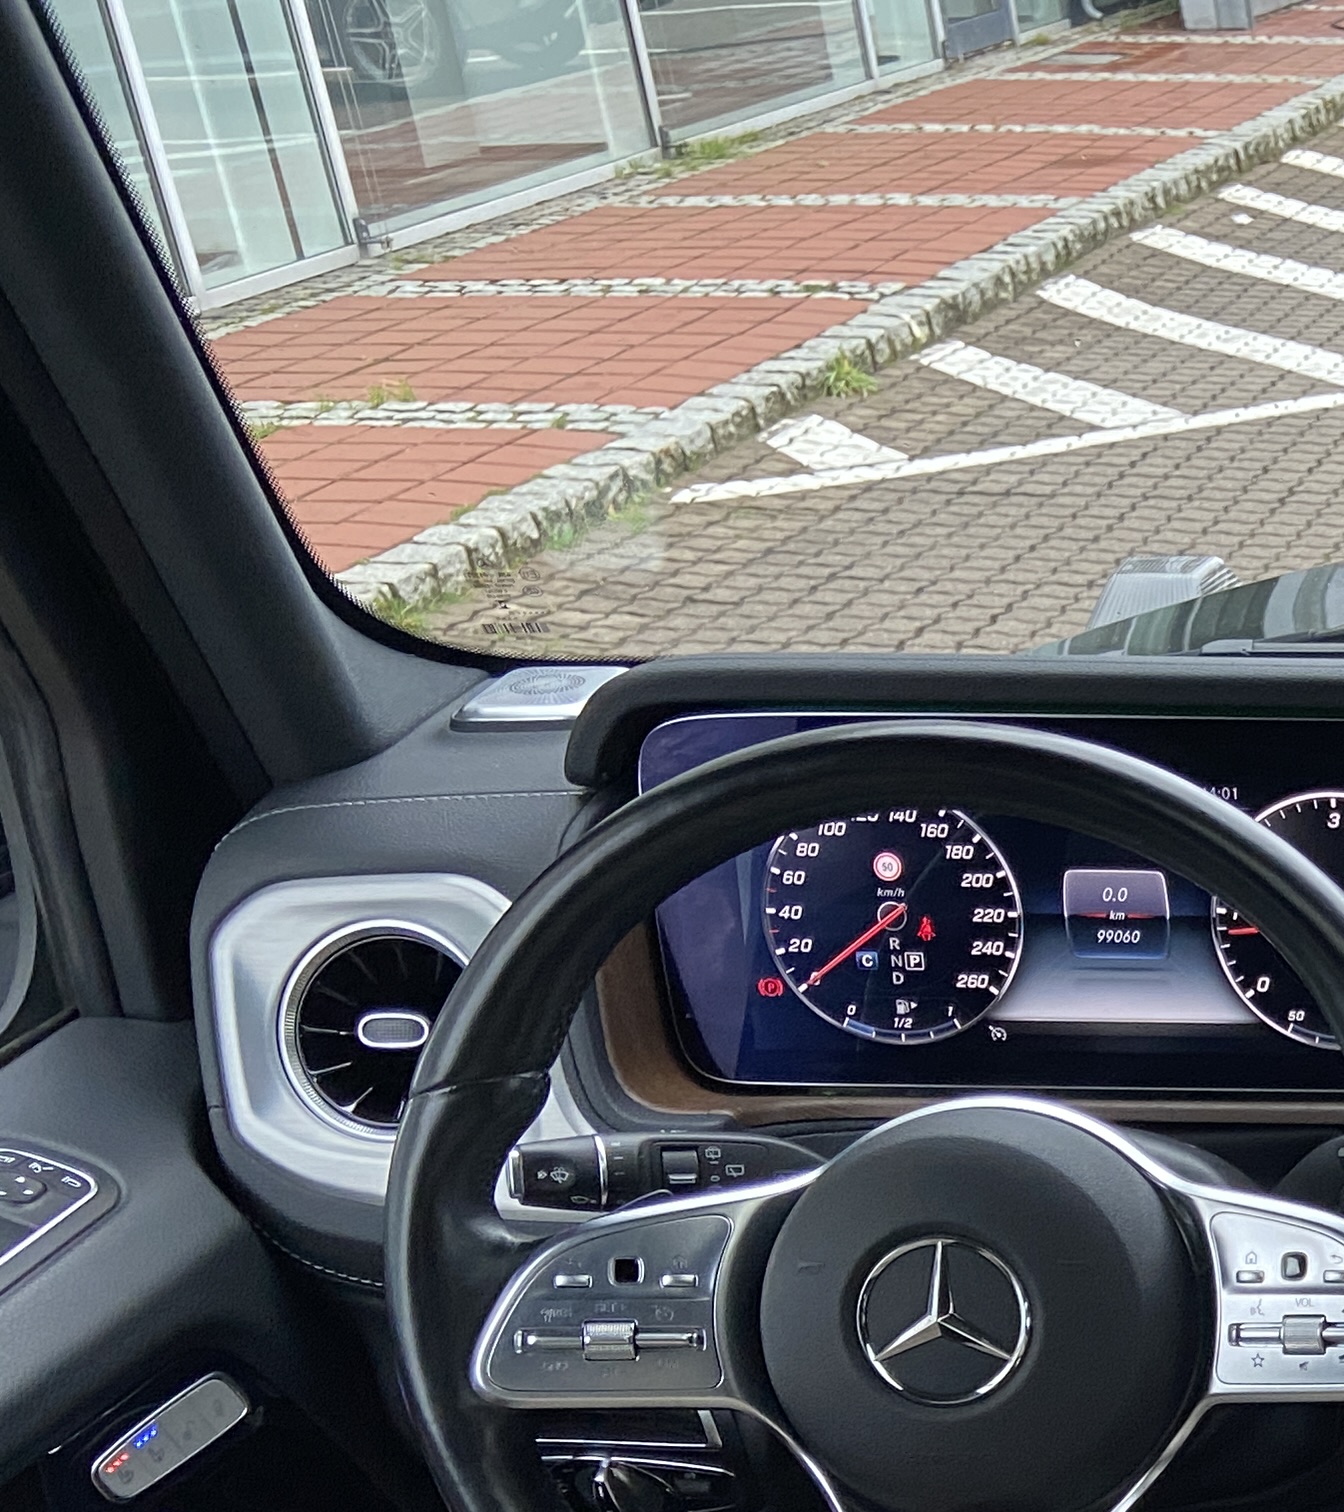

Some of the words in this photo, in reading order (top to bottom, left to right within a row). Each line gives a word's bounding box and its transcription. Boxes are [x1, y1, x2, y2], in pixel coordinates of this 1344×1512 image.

[1202, 787, 1238, 800] 4:01
[1326, 812, 1341, 829] 3
[817, 822, 847, 837] 100
[919, 823, 949, 838] 160
[795, 842, 820, 857] 80
[944, 844, 975, 860] 180
[881, 861, 894, 872] 50
[781, 870, 806, 886] 60
[960, 873, 994, 888] 200
[876, 888, 905, 898] km/h
[1101, 886, 1128, 902] 0.0
[777, 905, 804, 920] 40
[971, 908, 1006, 923] 220
[1108, 909, 1126, 921] km
[888, 937, 901, 950] R
[1096, 929, 1141, 944] 99060
[788, 938, 814, 954] 20
[970, 941, 1005, 957] 240
[890, 955, 903, 968] N
[892, 971, 905, 985] D
[955, 974, 990, 989] 260
[1256, 976, 1270, 992] 0
[846, 1004, 857, 1016] 0
[1287, 1009, 1305, 1022] 50
[893, 1017, 914, 1029] 1/2
[1295, 1297, 1315, 1307] VOL
